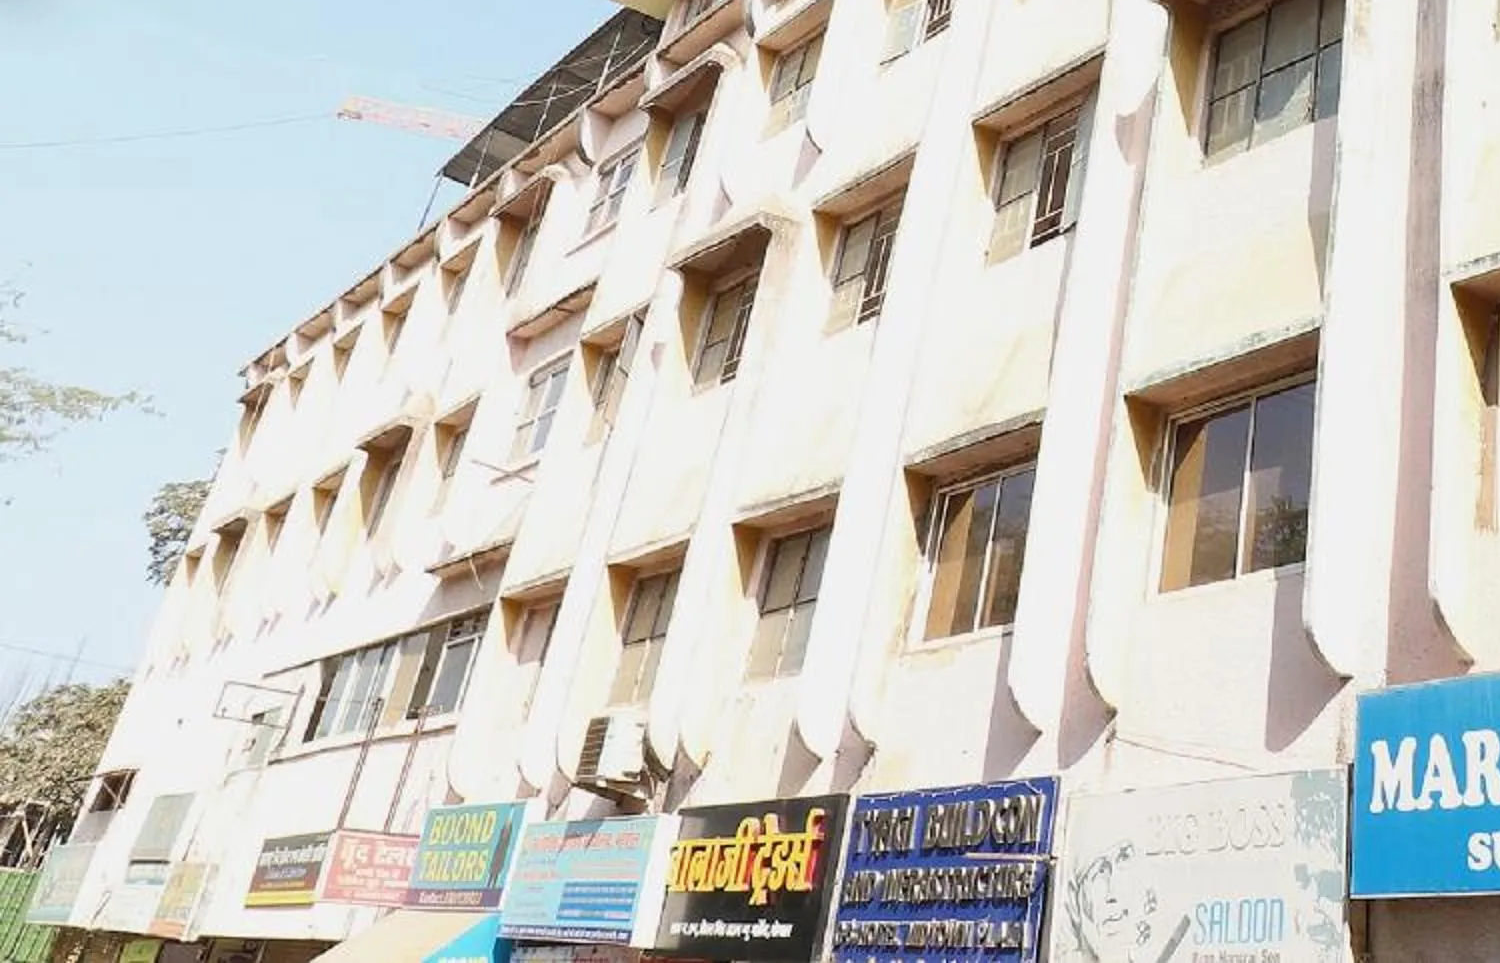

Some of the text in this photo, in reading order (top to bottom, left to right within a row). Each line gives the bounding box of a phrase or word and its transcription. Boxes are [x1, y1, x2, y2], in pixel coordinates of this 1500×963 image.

[428, 810, 497, 846] BOOND
[922, 794, 1047, 850] BUILDCON
[419, 848, 490, 882] TAILORS
[1193, 898, 1285, 946] SALOON
